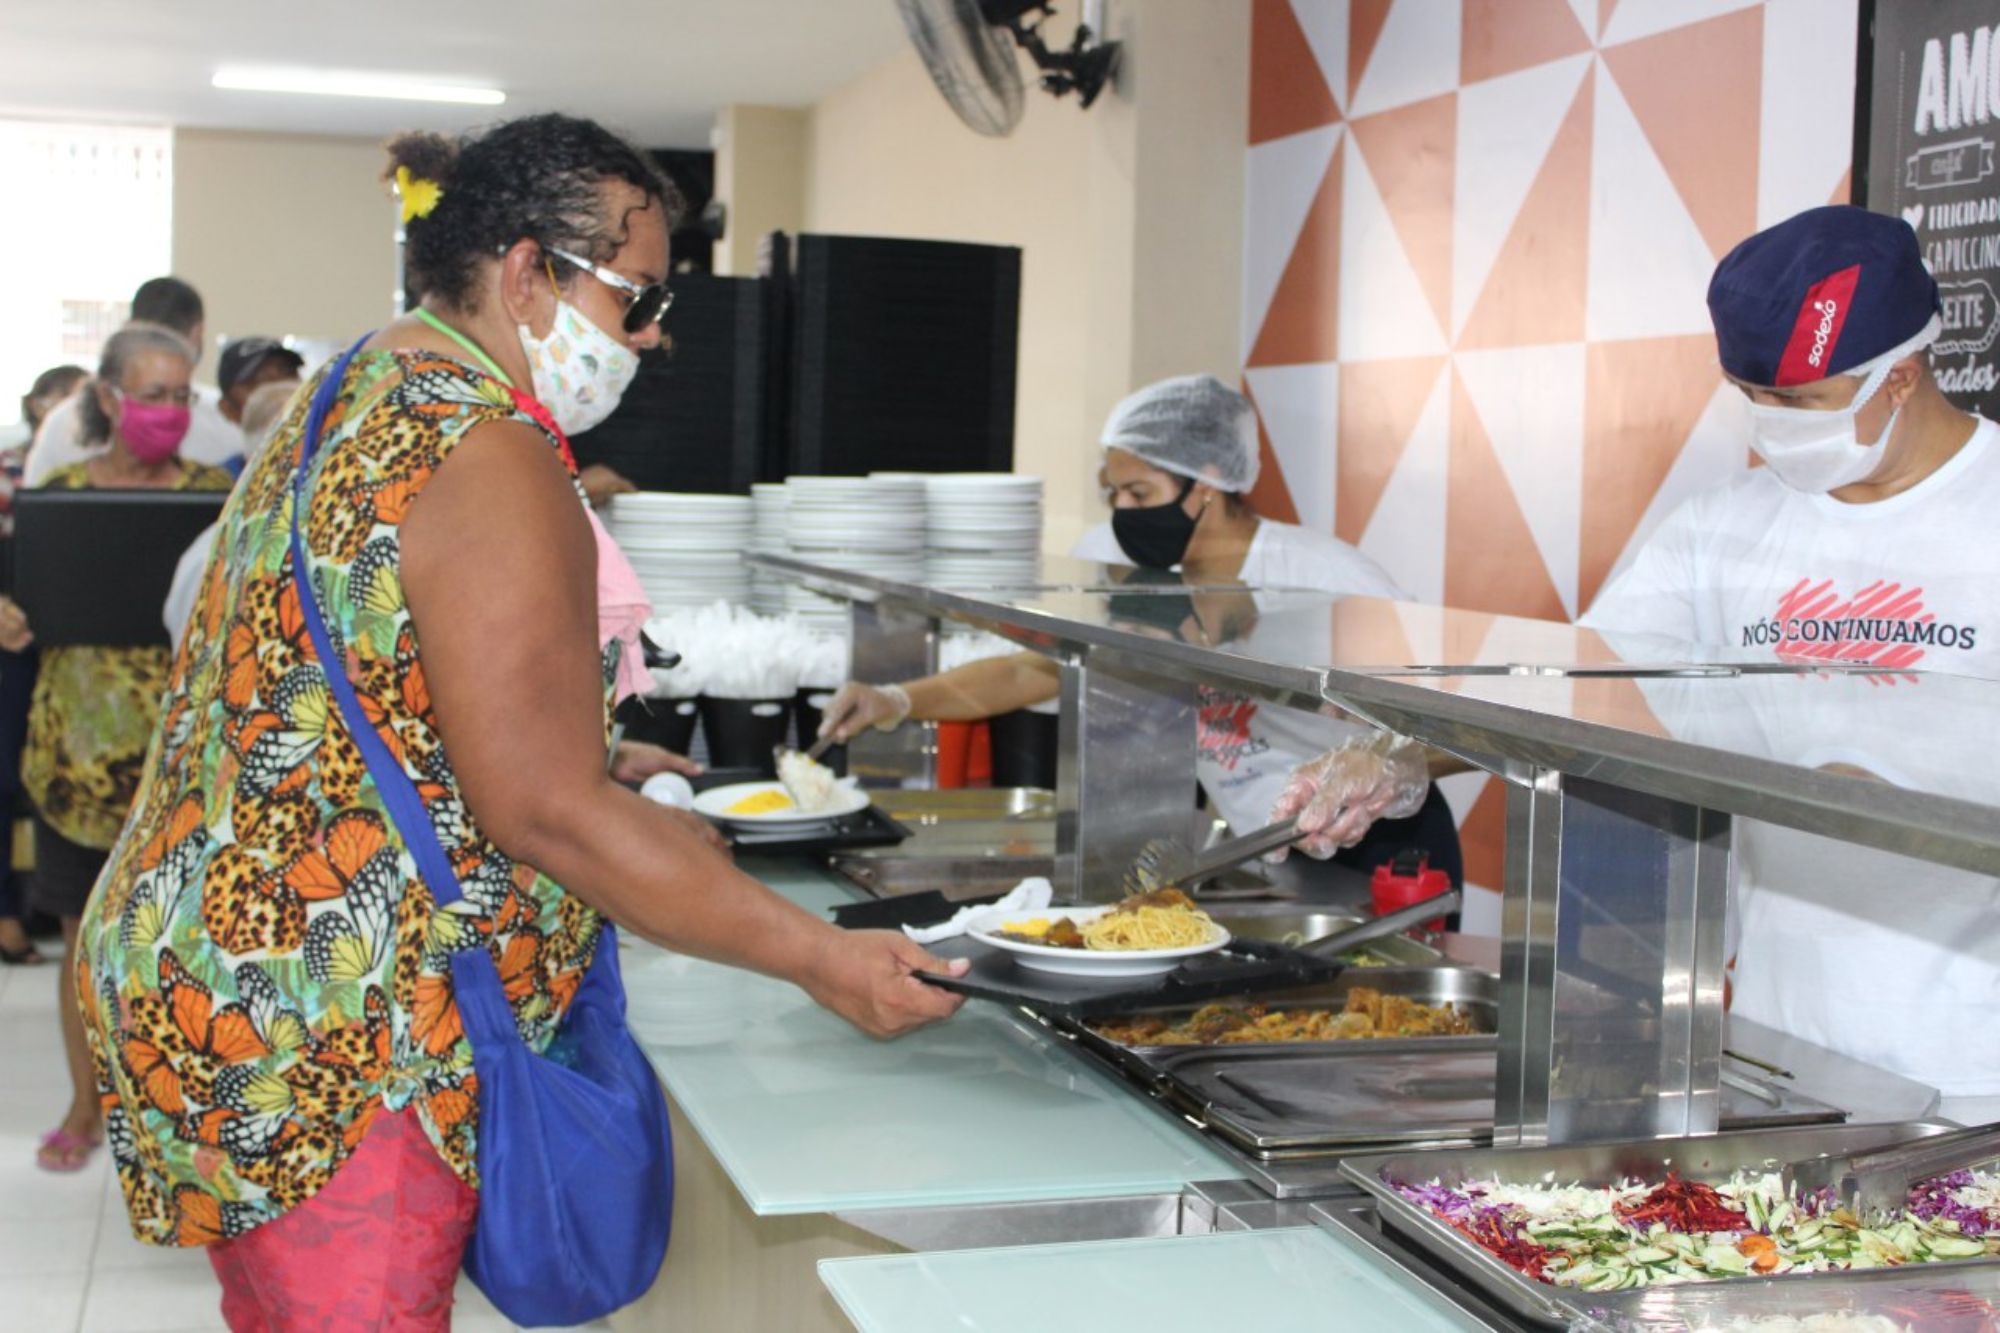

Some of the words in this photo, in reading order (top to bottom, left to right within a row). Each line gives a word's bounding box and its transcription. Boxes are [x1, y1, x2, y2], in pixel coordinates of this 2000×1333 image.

[1928, 196, 2000, 231] FELICIDAD
[1939, 293, 1984, 330] EITE
[1808, 299, 1837, 368] sodexo
[1933, 353, 2000, 393] ados
[1742, 617, 1780, 647] NÓS
